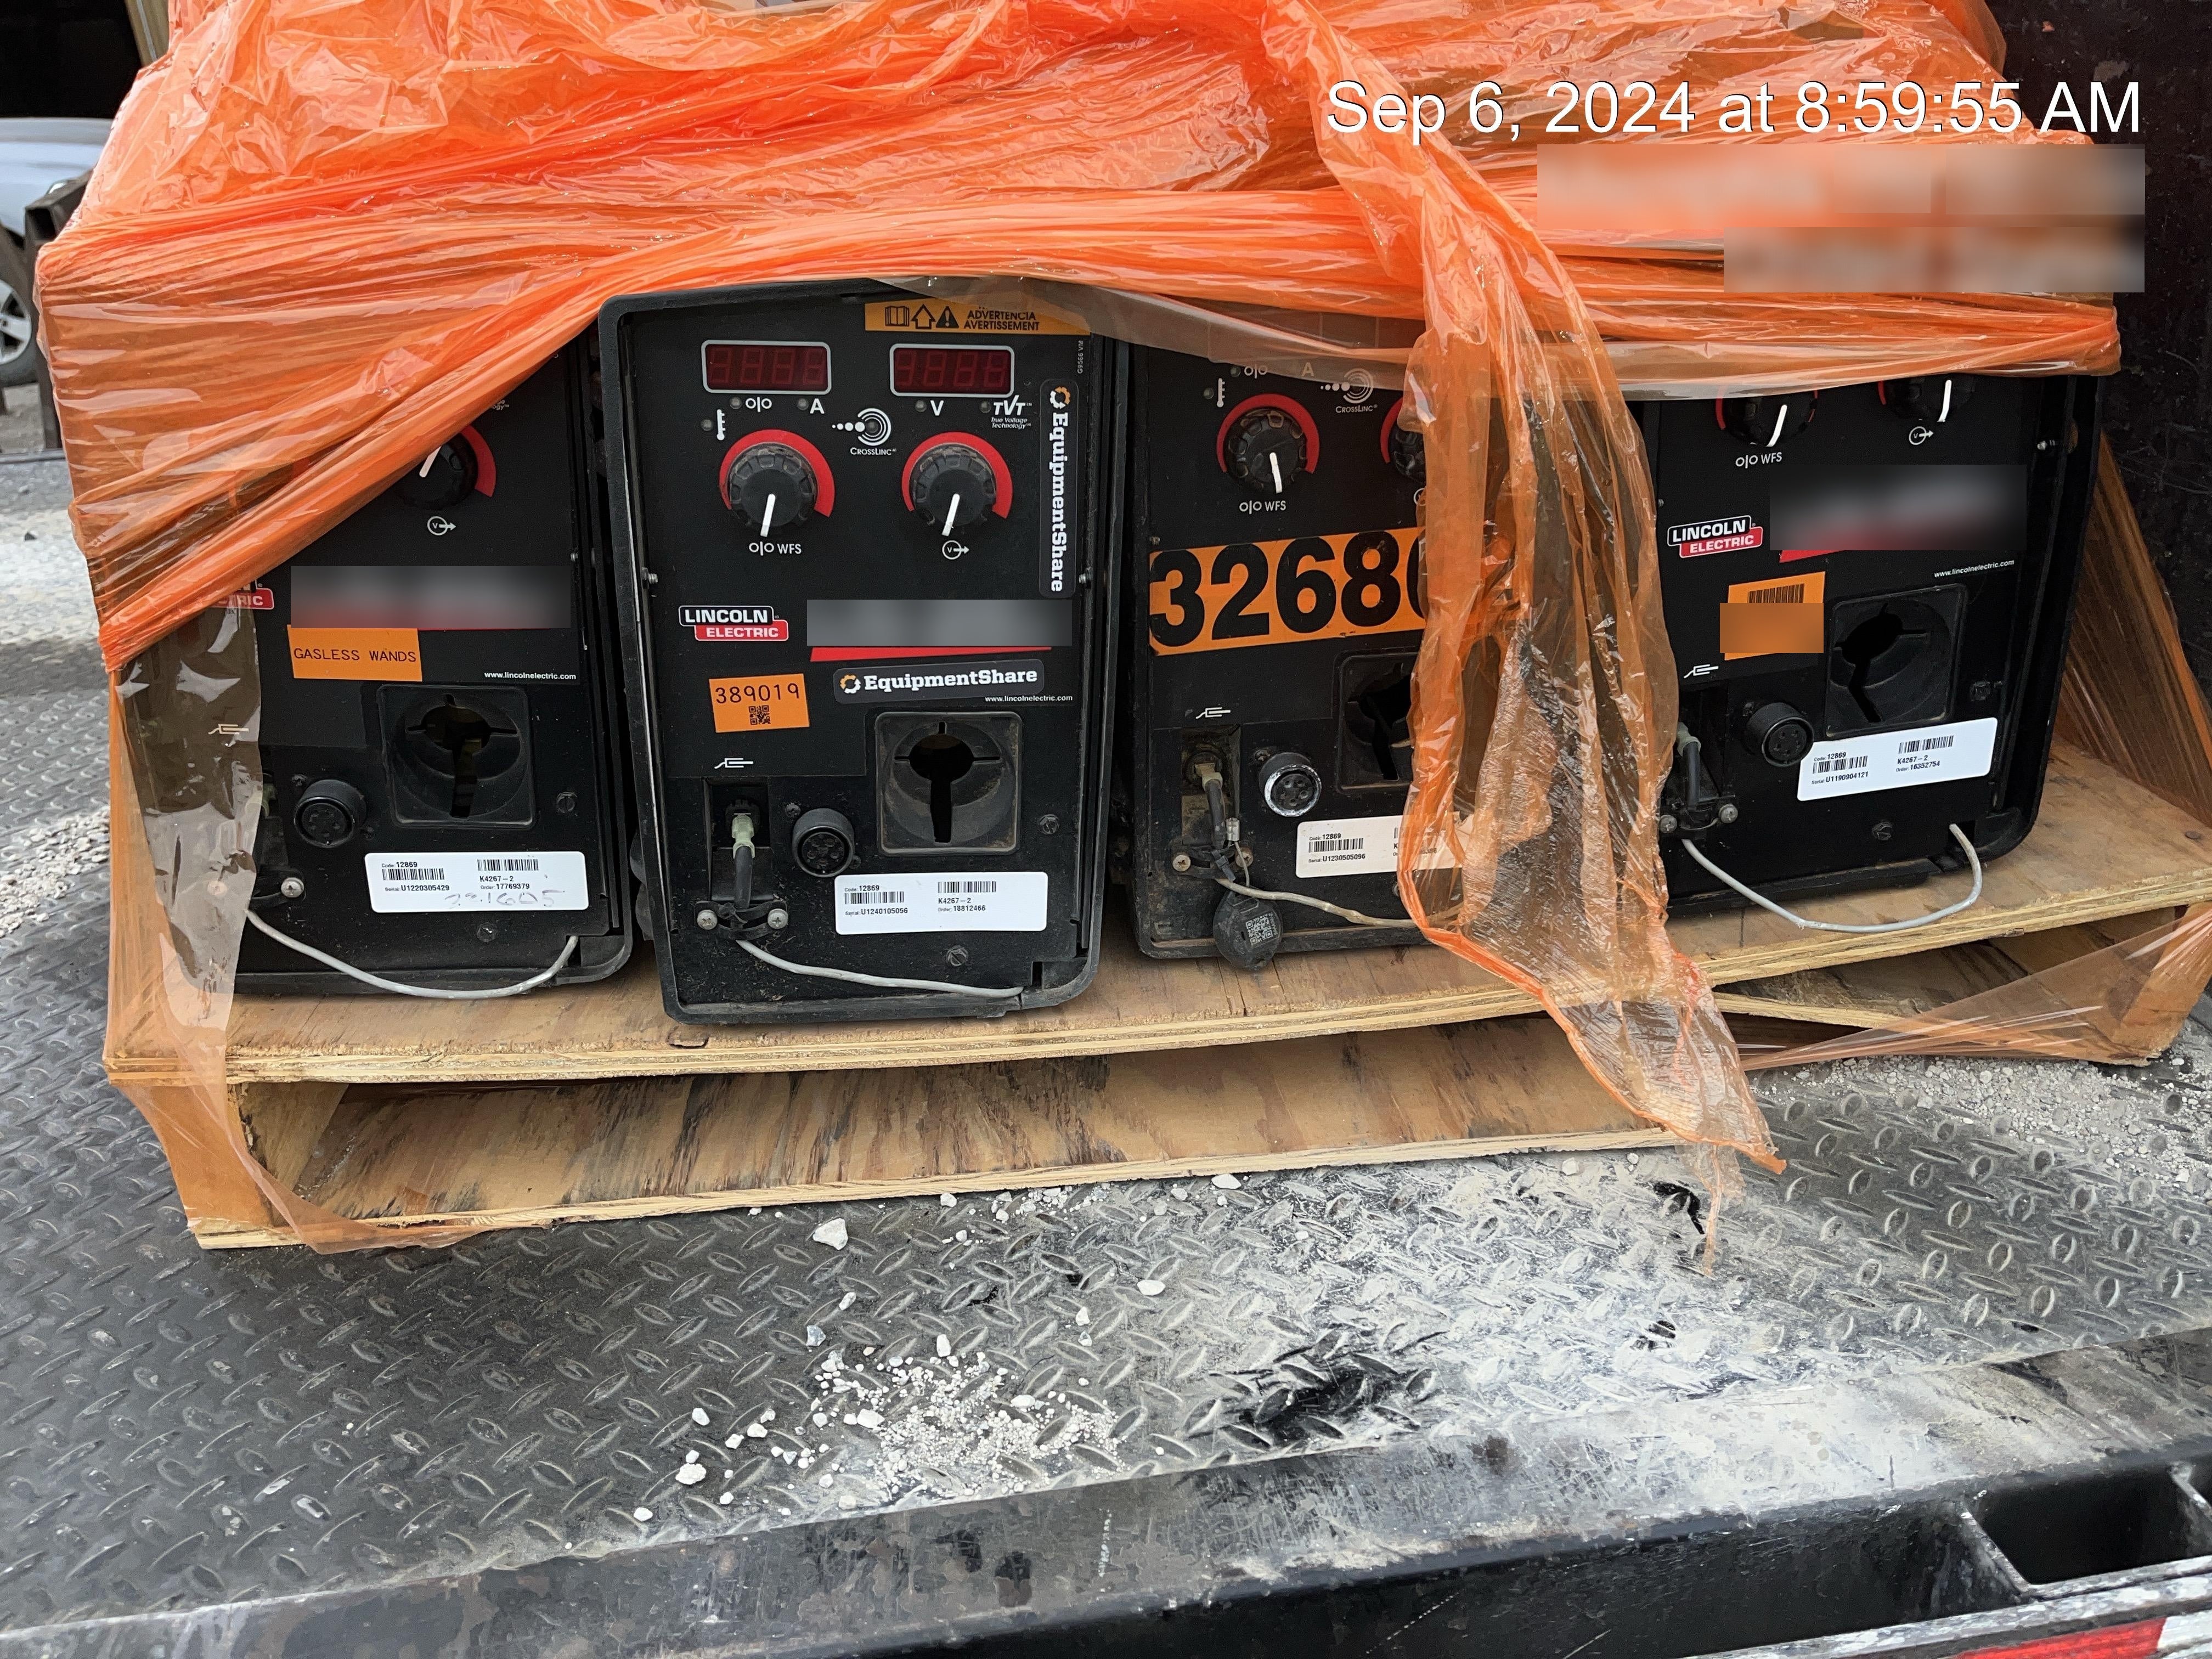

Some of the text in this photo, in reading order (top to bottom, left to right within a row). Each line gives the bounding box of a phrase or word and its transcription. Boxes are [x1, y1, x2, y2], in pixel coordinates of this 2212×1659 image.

[967, 310, 1036, 321] ADVERTENCIA
[964, 320, 1040, 330] AVERTISSEMENT
[1301, 362, 1314, 377] A
[810, 398, 825, 414] A
[930, 400, 944, 416] V
[1760, 452, 1782, 465] WFS
[1049, 412, 1068, 592] EquipmentShare
[1264, 500, 1286, 512] WFS
[1673, 519, 1746, 543] LINCOLN
[777, 543, 802, 555] WFS
[1690, 534, 1754, 554] ELECTRIC
[1934, 560, 2015, 578] www.lincolnelectric.com
[685, 610, 768, 623] LINCOLN
[706, 627, 778, 638] ELECTRIC
[294, 648, 416, 662] GASLESS WANDS
[484, 672, 577, 680] www.lincolnelectric.com
[864, 669, 1037, 693] EquipmentShare
[715, 682, 799, 704] 389019
[1827, 752, 1847, 760] 12869
[1911, 760, 1940, 770] 16352754
[1826, 771, 1869, 783] U1190904121
[1323, 854, 1366, 862] U1230505096
